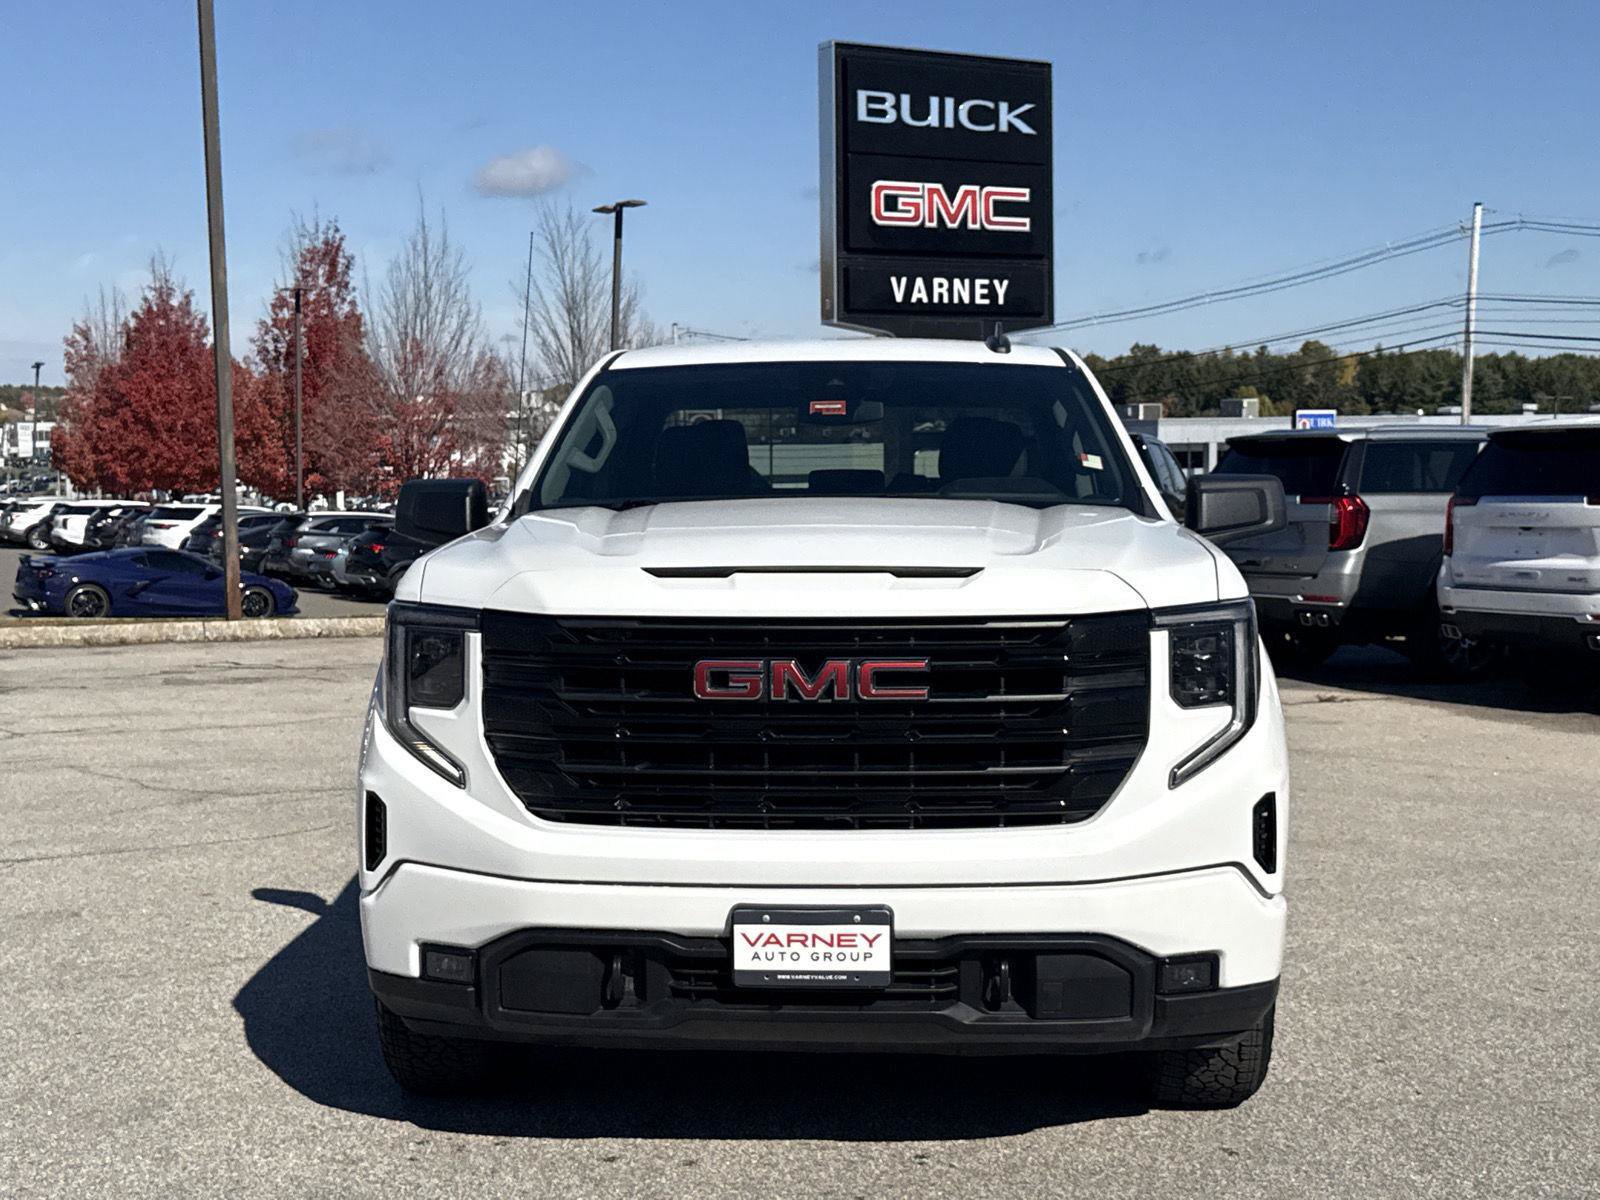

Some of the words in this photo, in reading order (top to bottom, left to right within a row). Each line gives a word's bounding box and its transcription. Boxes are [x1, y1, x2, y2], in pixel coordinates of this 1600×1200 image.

[856, 89, 1037, 135] BUICK
[870, 180, 1031, 232] GMC
[890, 276, 1009, 305] VARNEY
[693, 657, 930, 700] GMC
[740, 932, 882, 948] VARNEY
[751, 951, 801, 962] AUTO
[810, 951, 873, 962] GROUP
